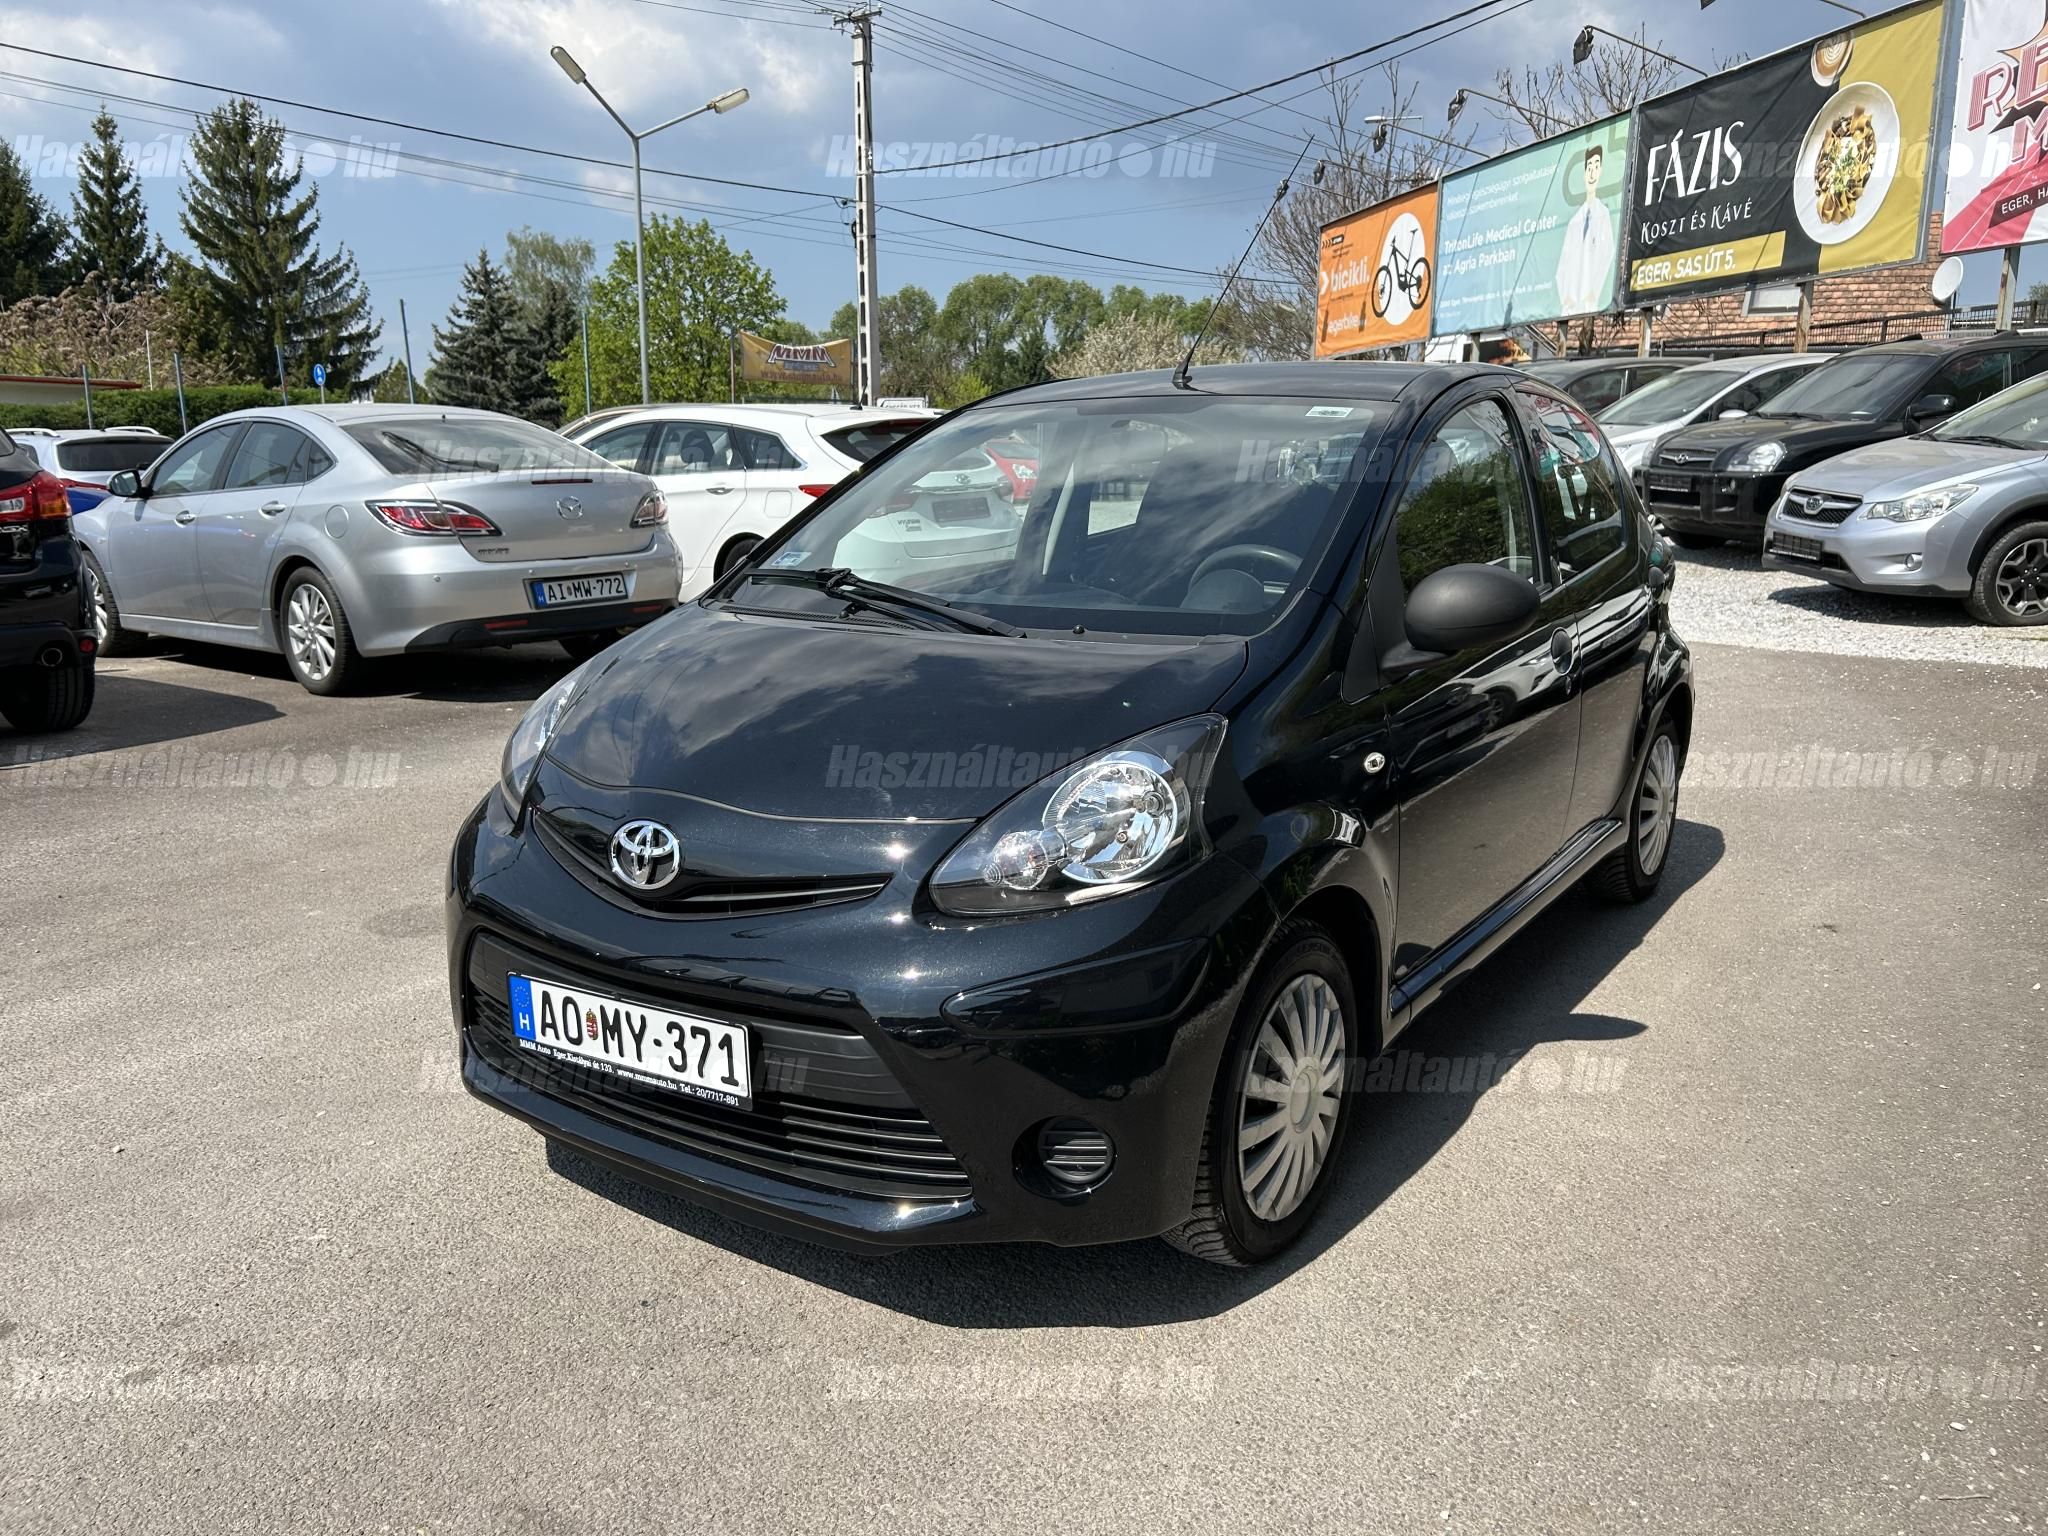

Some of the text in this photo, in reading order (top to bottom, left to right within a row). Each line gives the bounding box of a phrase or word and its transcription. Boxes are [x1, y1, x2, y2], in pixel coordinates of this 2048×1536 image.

[1645, 120, 1745, 207] FÁZIS
[2001, 194, 2033, 214] EGER,
[1486, 221, 1522, 245] Medical
[1523, 215, 1558, 235] Center
[1641, 197, 1753, 245] KOSZT ÉS KÁVÉ
[1453, 255, 1477, 275] Agria
[1478, 248, 1516, 267] Parkban
[1636, 248, 1737, 286] EGER, SAS ÚT 5.
[518, 1011, 531, 1031] H
